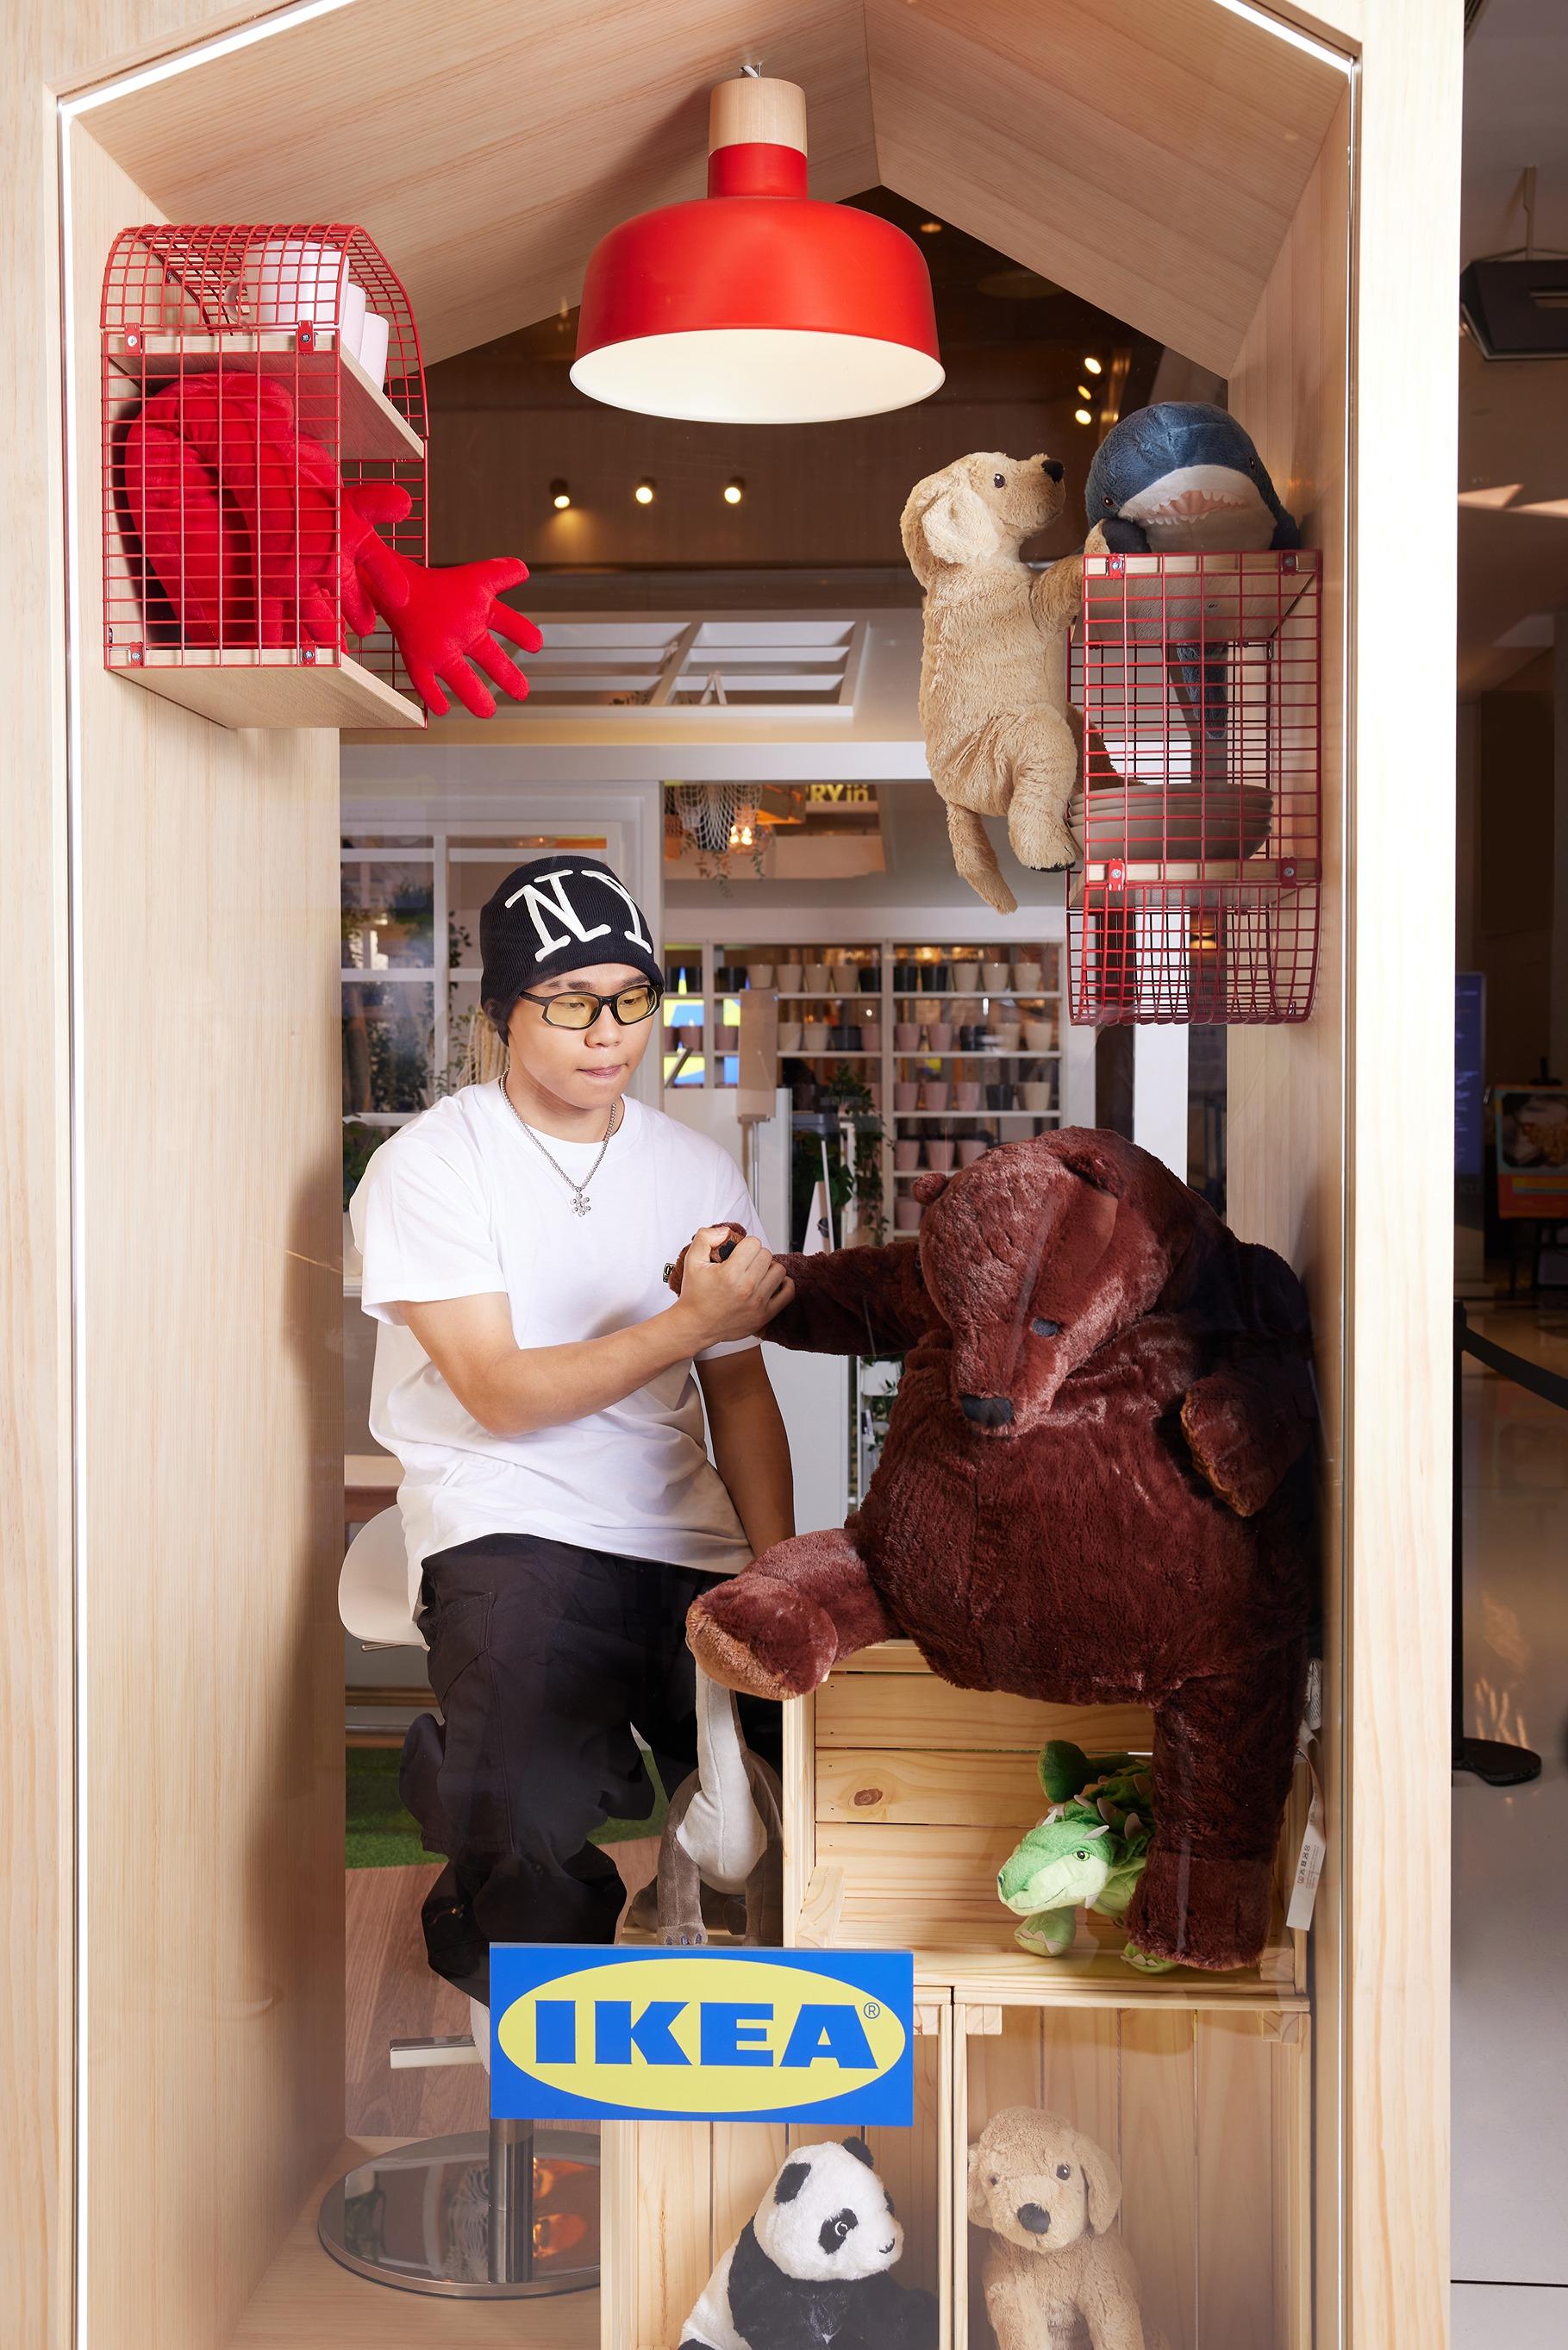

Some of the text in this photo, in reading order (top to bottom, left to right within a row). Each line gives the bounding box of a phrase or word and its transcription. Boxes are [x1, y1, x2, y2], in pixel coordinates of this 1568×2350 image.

[805, 784, 844, 803] RY
[505, 869, 653, 962] NY
[534, 1999, 879, 2070] IKEA
